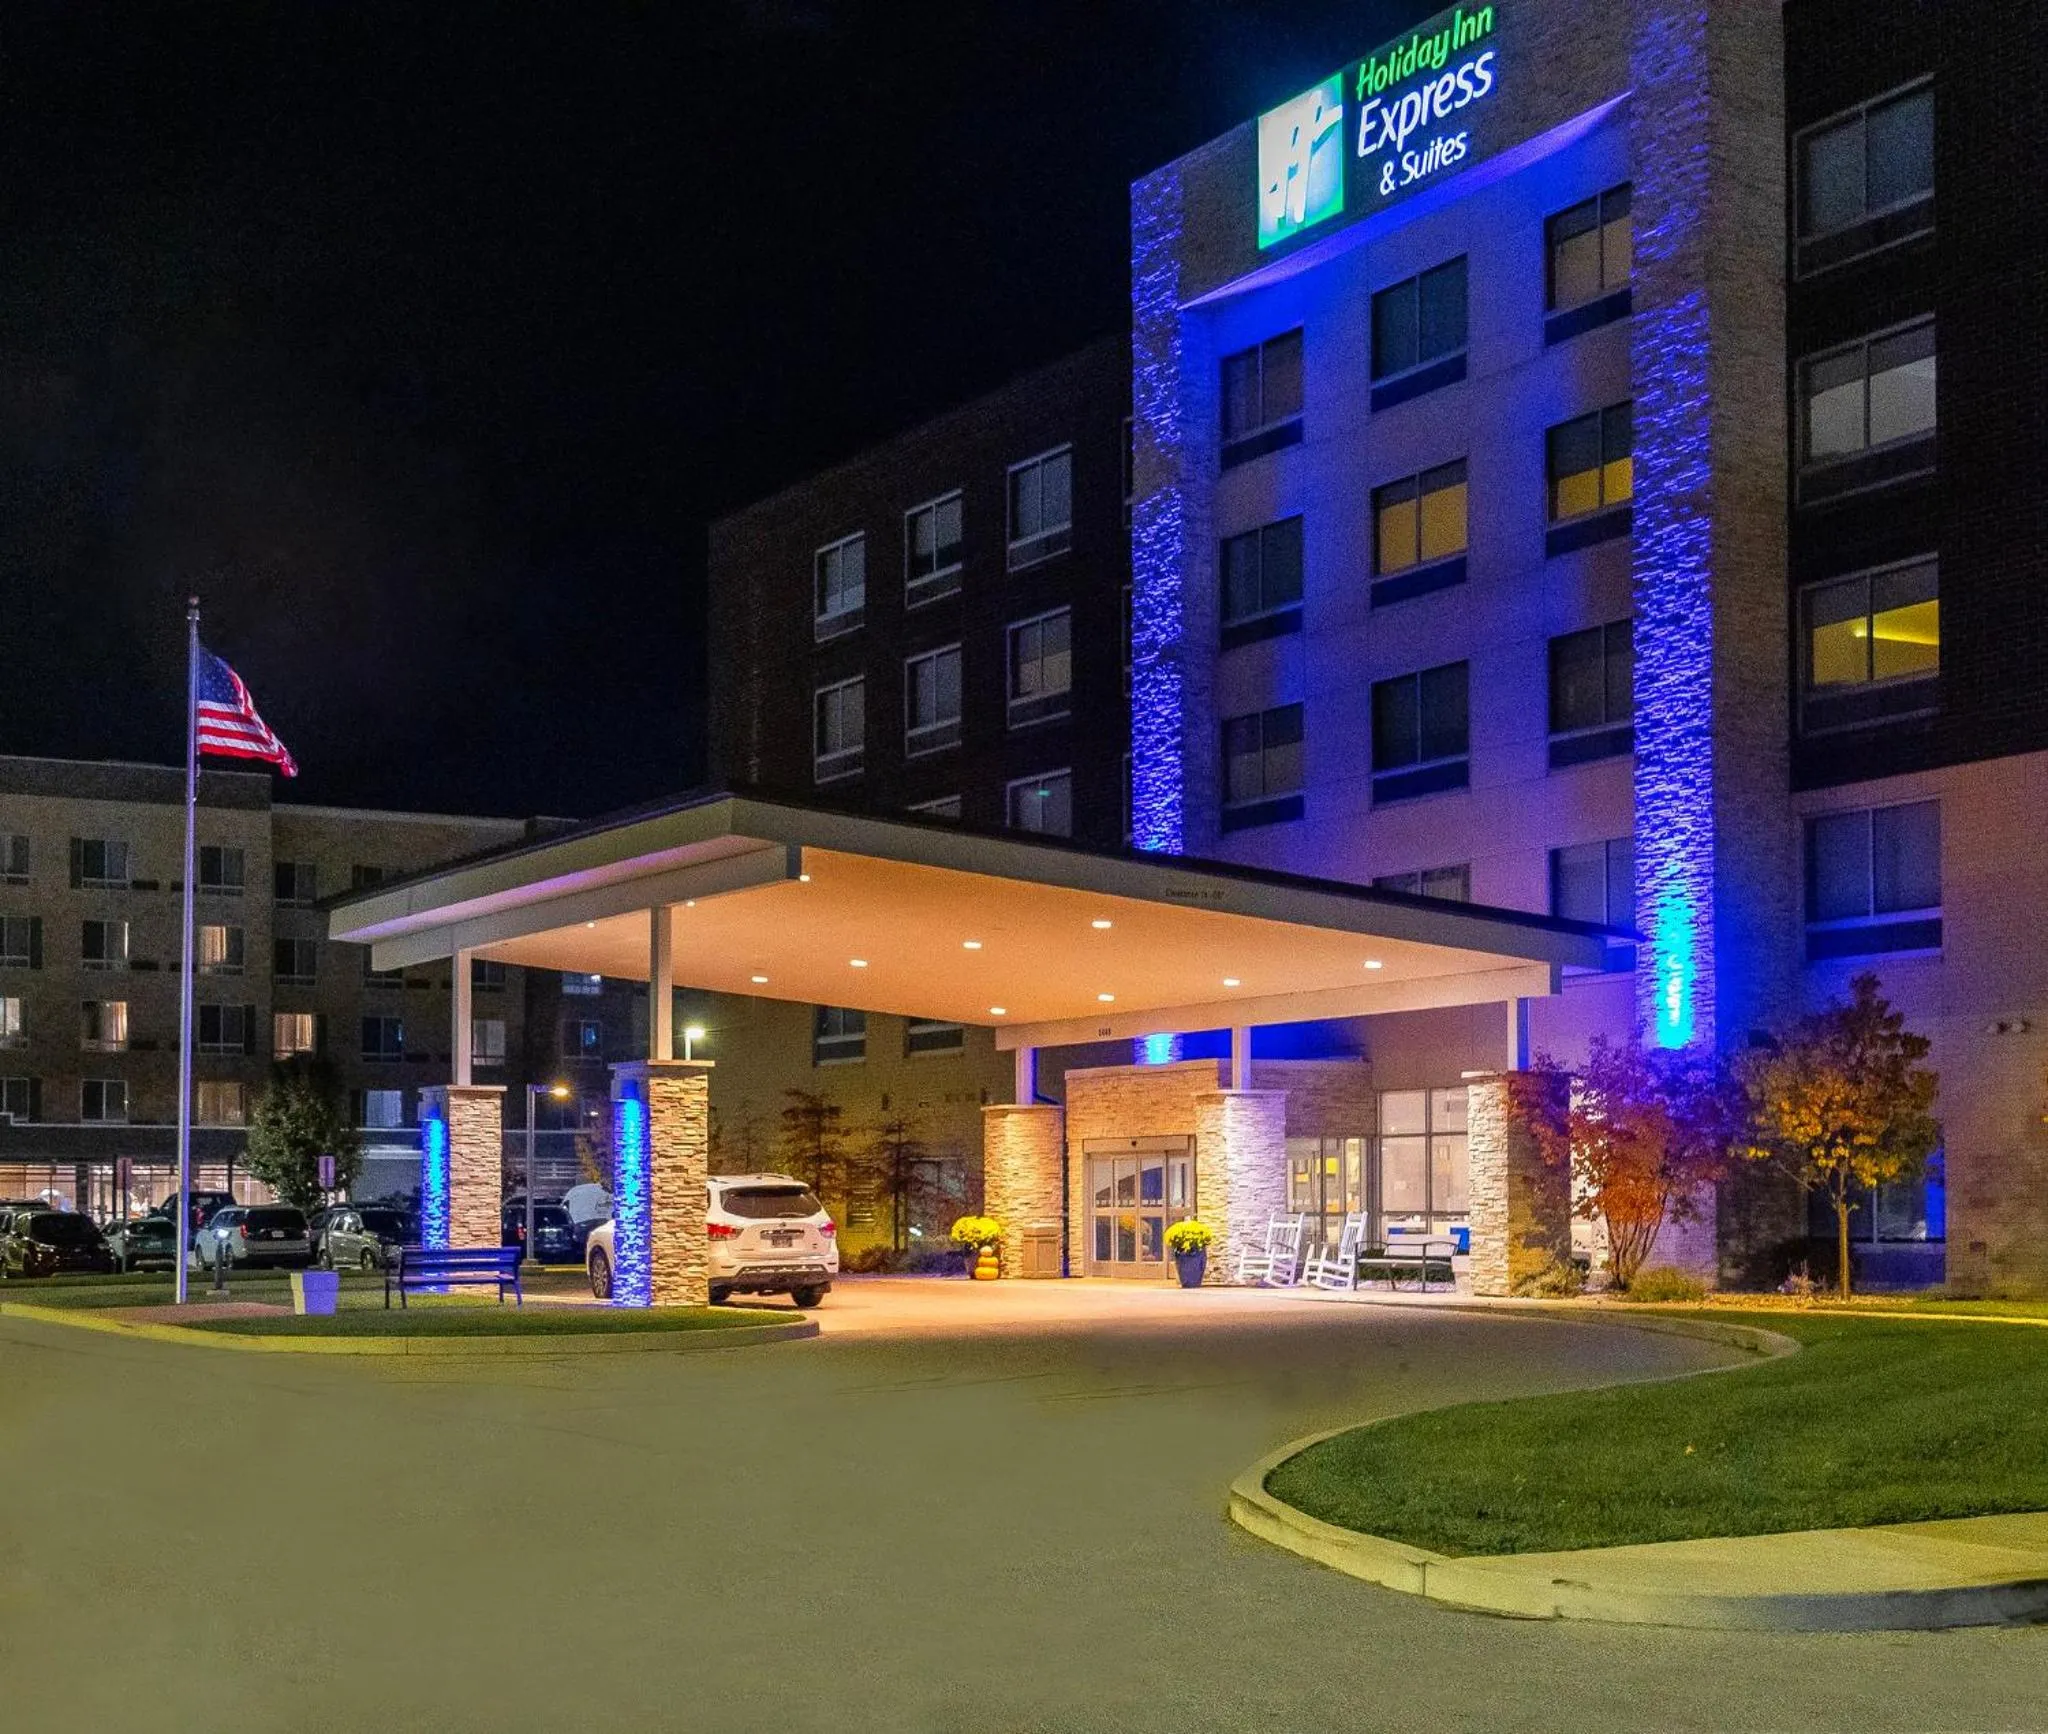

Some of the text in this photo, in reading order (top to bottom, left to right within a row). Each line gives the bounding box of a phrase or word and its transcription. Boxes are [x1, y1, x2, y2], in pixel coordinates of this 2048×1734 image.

[1356, 6, 1493, 101] Holiday Inn
[1358, 51, 1496, 157] Express
[1379, 131, 1468, 196] & Suites
